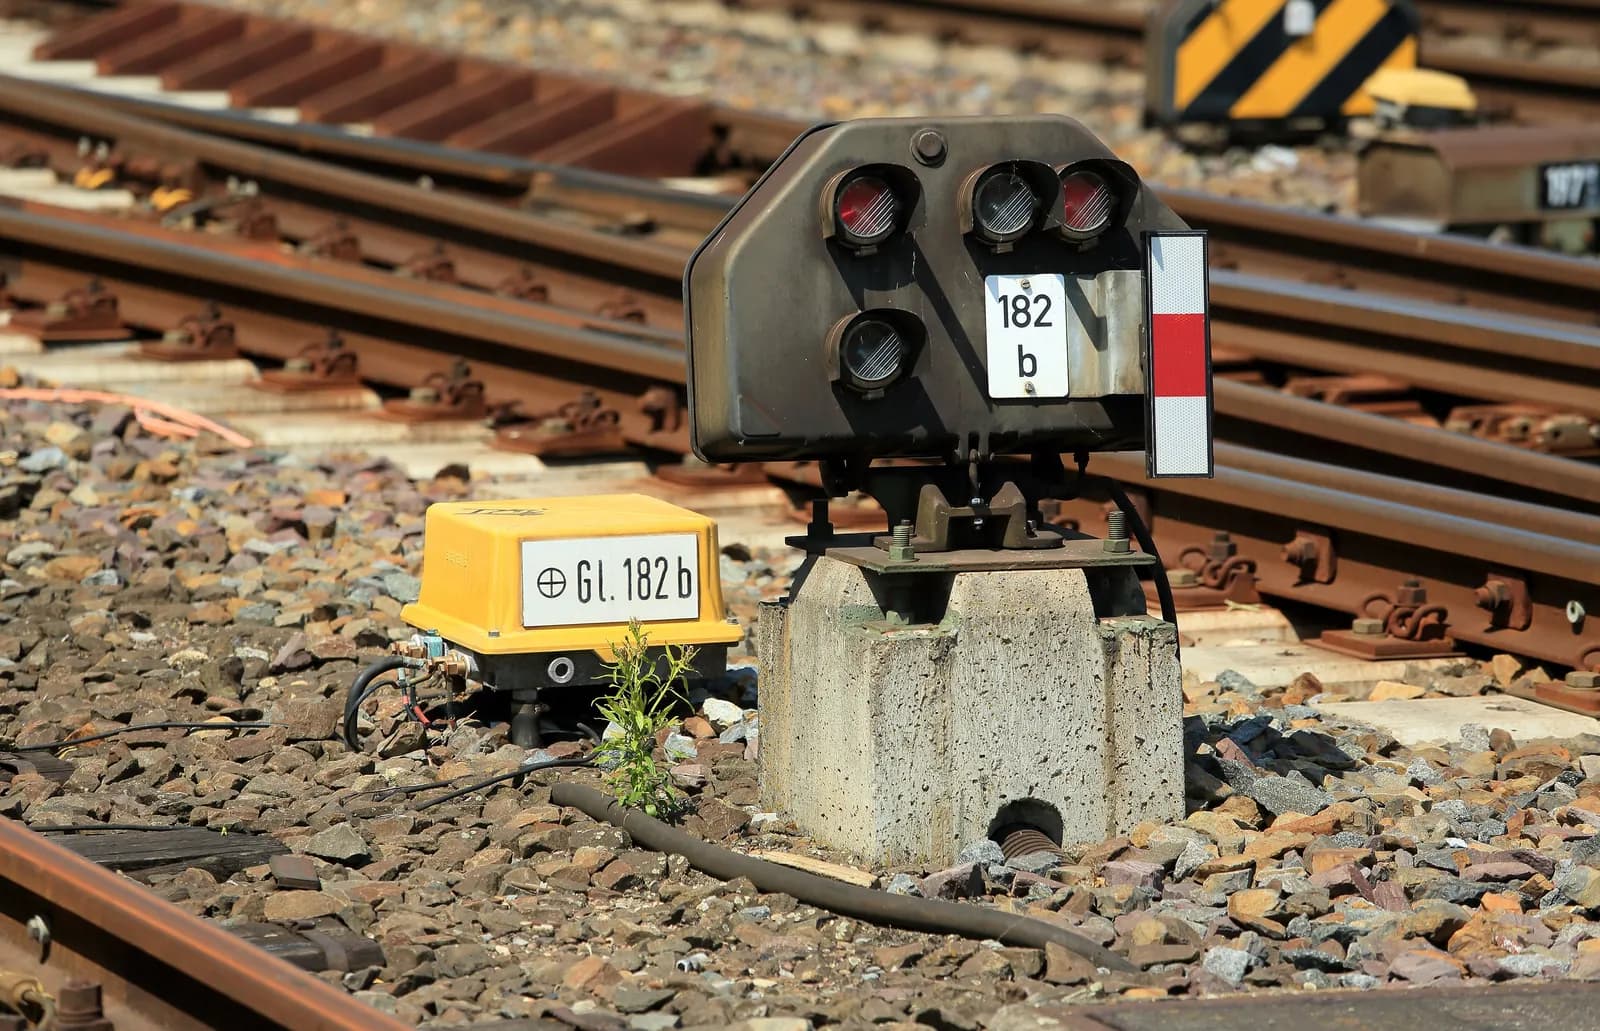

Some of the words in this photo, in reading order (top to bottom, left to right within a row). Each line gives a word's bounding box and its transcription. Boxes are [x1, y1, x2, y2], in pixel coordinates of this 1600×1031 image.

[998, 293, 1053, 328] 182
[1017, 344, 1038, 378] b
[577, 559, 615, 604] Gl.
[623, 556, 669, 601] 182
[677, 555, 692, 599] b
